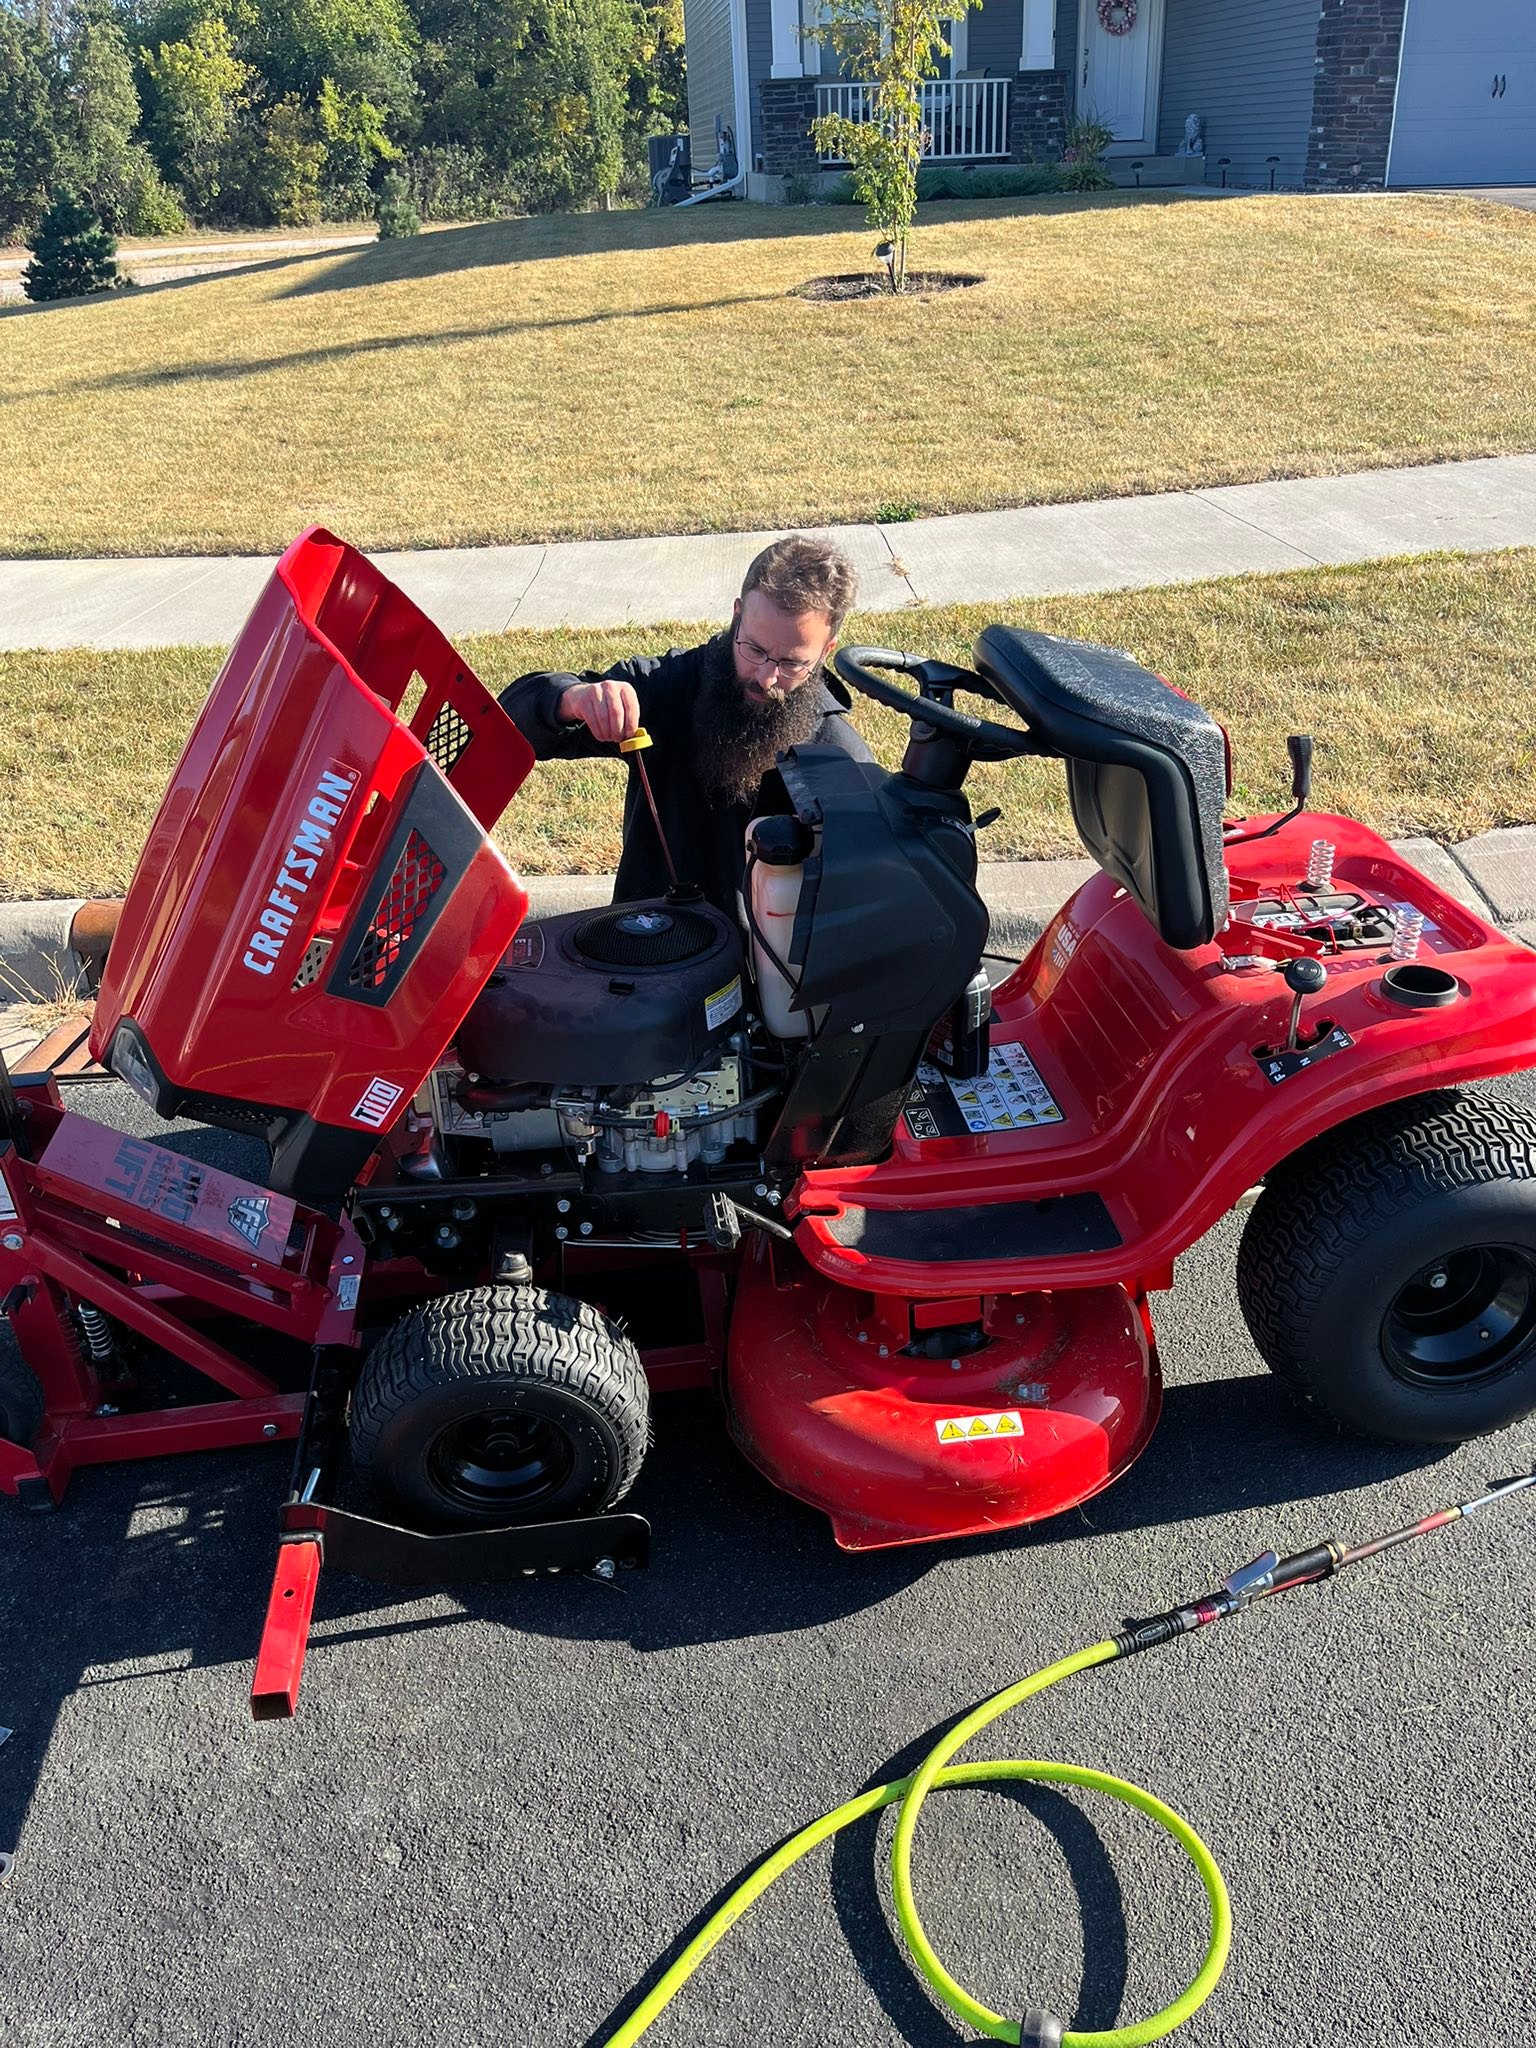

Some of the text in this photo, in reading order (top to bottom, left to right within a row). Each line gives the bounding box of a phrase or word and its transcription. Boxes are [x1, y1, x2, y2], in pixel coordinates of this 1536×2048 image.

[1057, 923, 1077, 957] USA
[1299, 1056, 1312, 1067] N
[1339, 1039, 1350, 1048] R
[1273, 1073, 1286, 1082] F
[354, 1081, 398, 1122] T110
[104, 1137, 152, 1199] LIFT
[138, 1151, 174, 1207] SERIES
[160, 1159, 206, 1222] PRO
